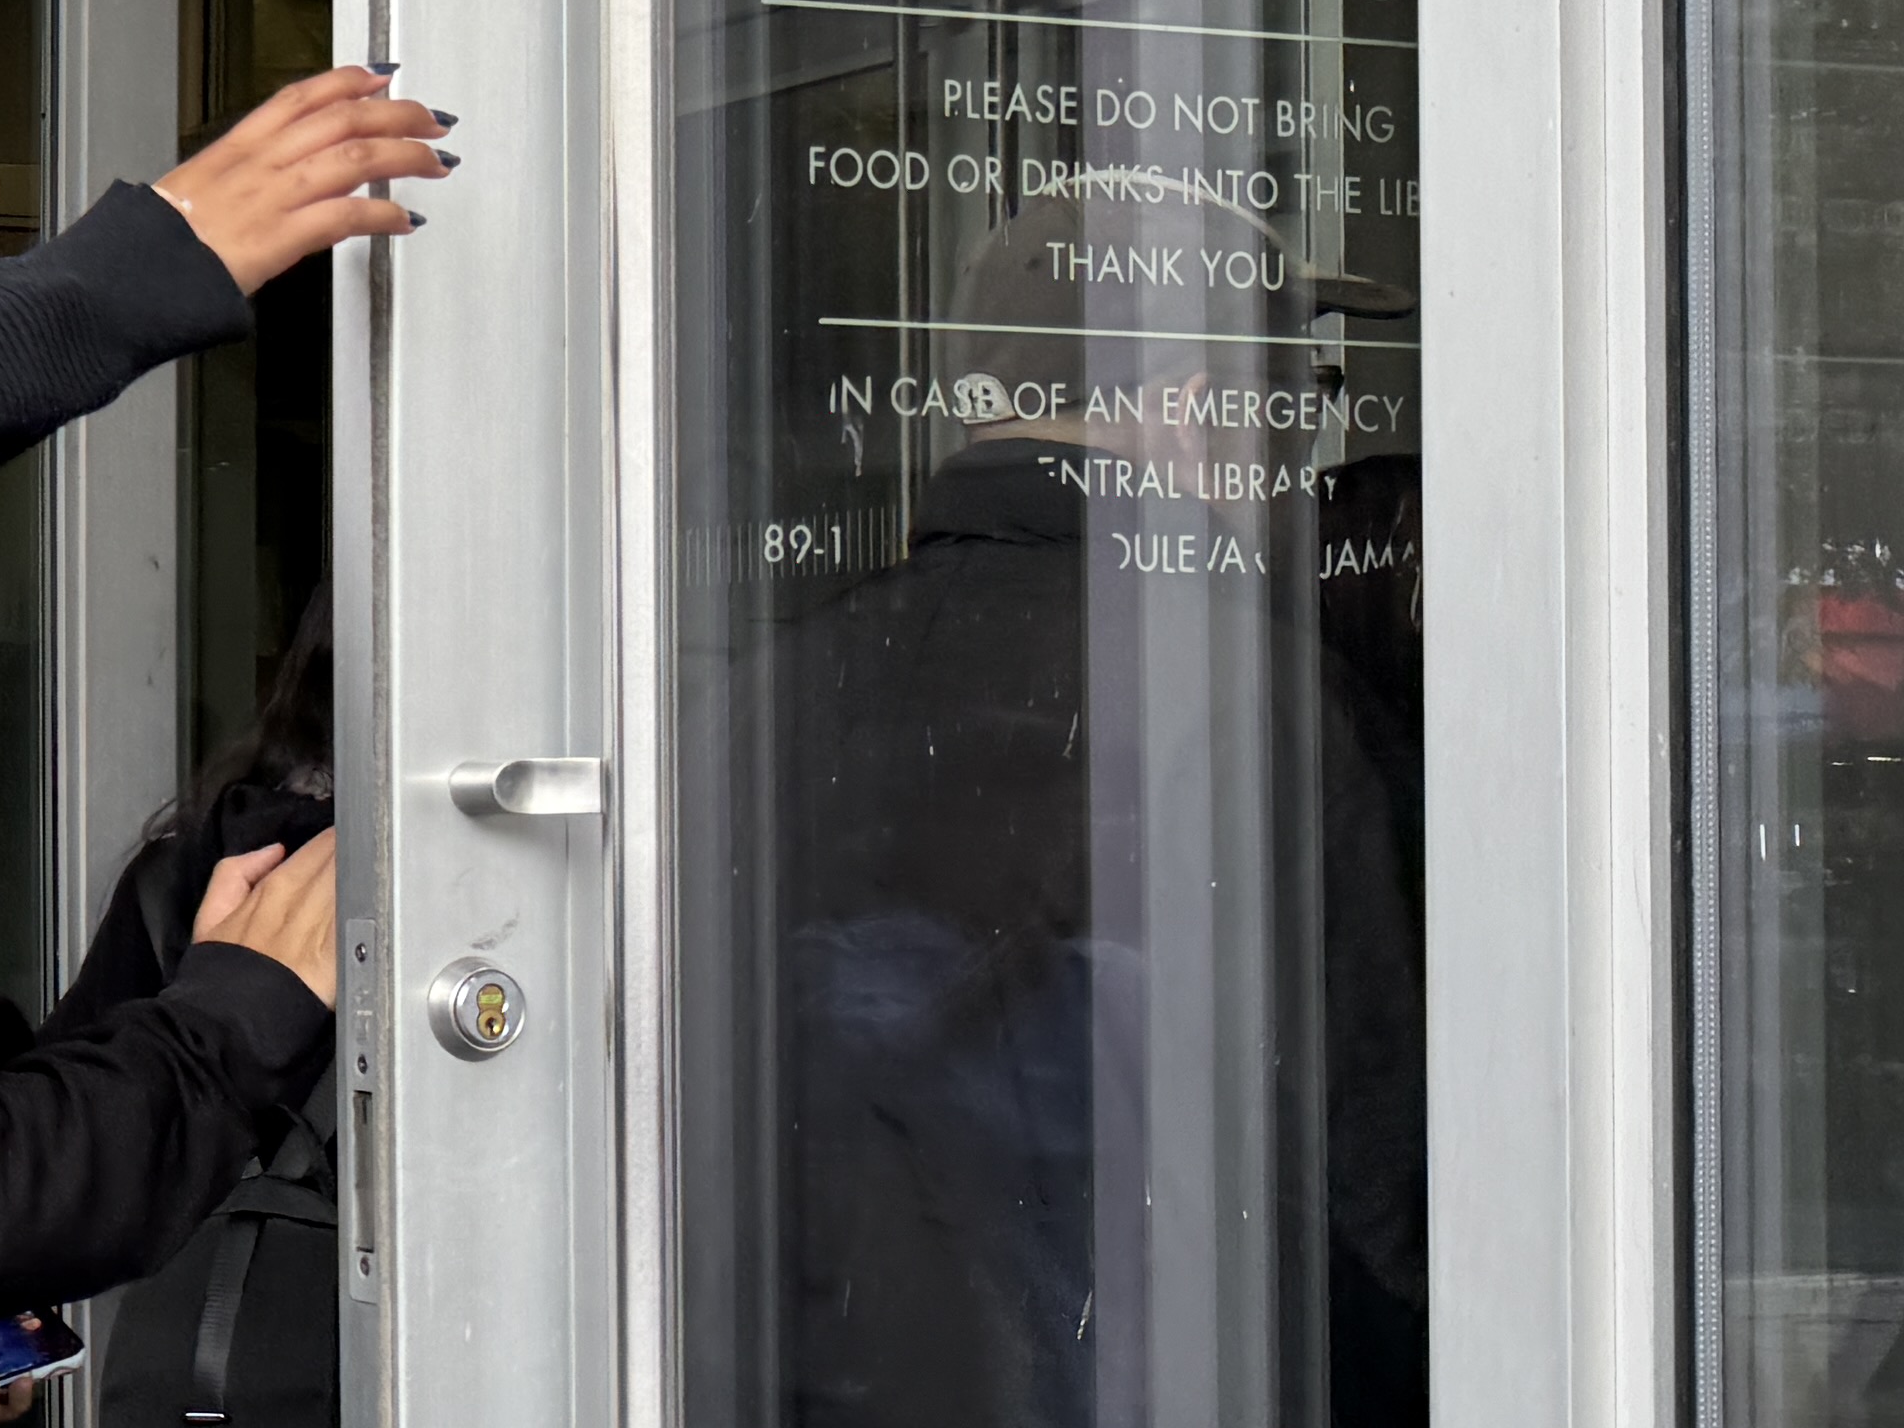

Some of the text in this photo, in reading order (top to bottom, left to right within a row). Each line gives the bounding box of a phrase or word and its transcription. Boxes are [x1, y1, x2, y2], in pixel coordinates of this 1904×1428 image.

[944, 80, 1395, 144] PLEASE DO NOT BRING
[809, 146, 930, 192] FOOD
[947, 155, 1005, 196] OR
[1022, 158, 1165, 205] DRINKS
[1182, 167, 1278, 210] INTO
[1294, 172, 1362, 214] THE
[1047, 242, 1285, 292] THANK YOU
[829, 375, 1405, 433] IN CASE OF AN EMERGENCY
[1196, 462, 1336, 502] LIBRARY
